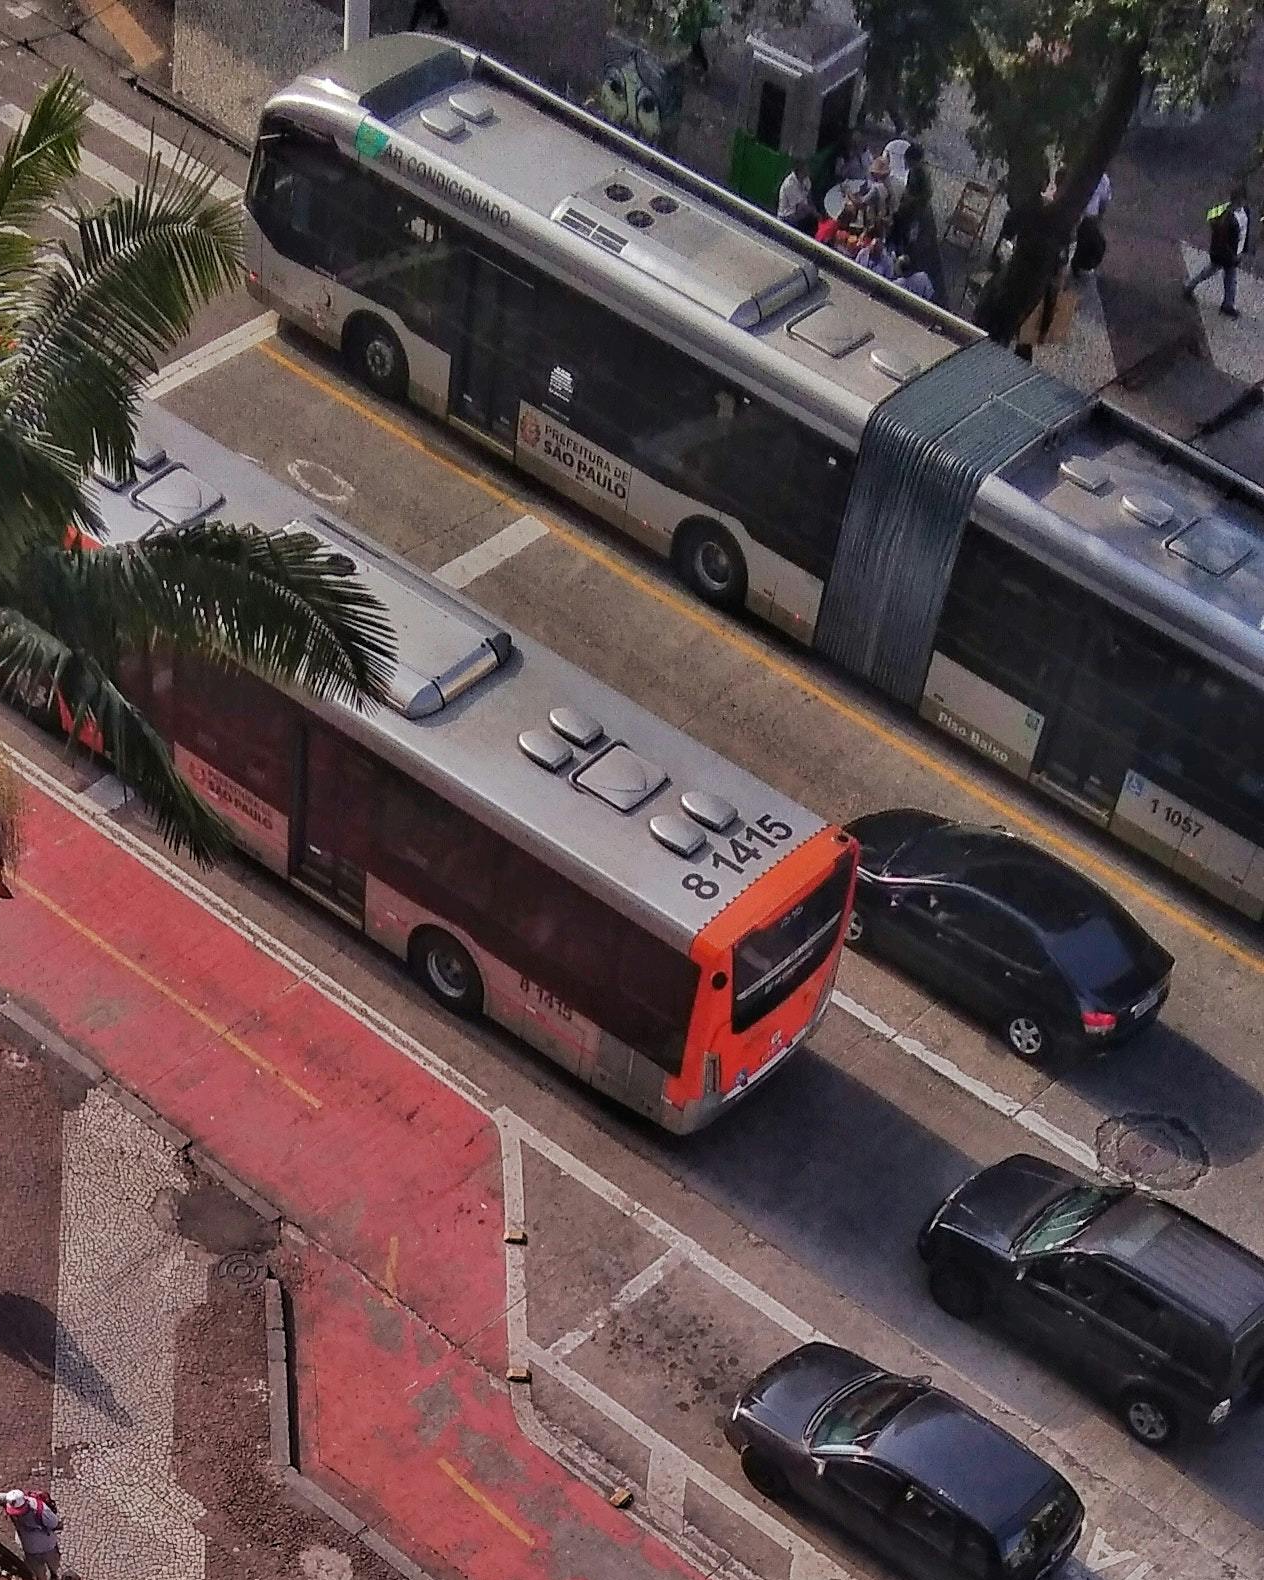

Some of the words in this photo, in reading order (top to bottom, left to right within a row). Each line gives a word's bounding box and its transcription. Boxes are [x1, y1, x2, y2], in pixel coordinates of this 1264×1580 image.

[407, 156, 511, 227] CONDICIONADO
[543, 440, 574, 468] SÃO
[576, 459, 626, 499] PAULO
[544, 424, 611, 473] PREFEITURA
[613, 466, 629, 482] DE
[1165, 806, 1205, 837] 1057
[681, 873, 720, 900] 8
[712, 814, 793, 874] 1415
